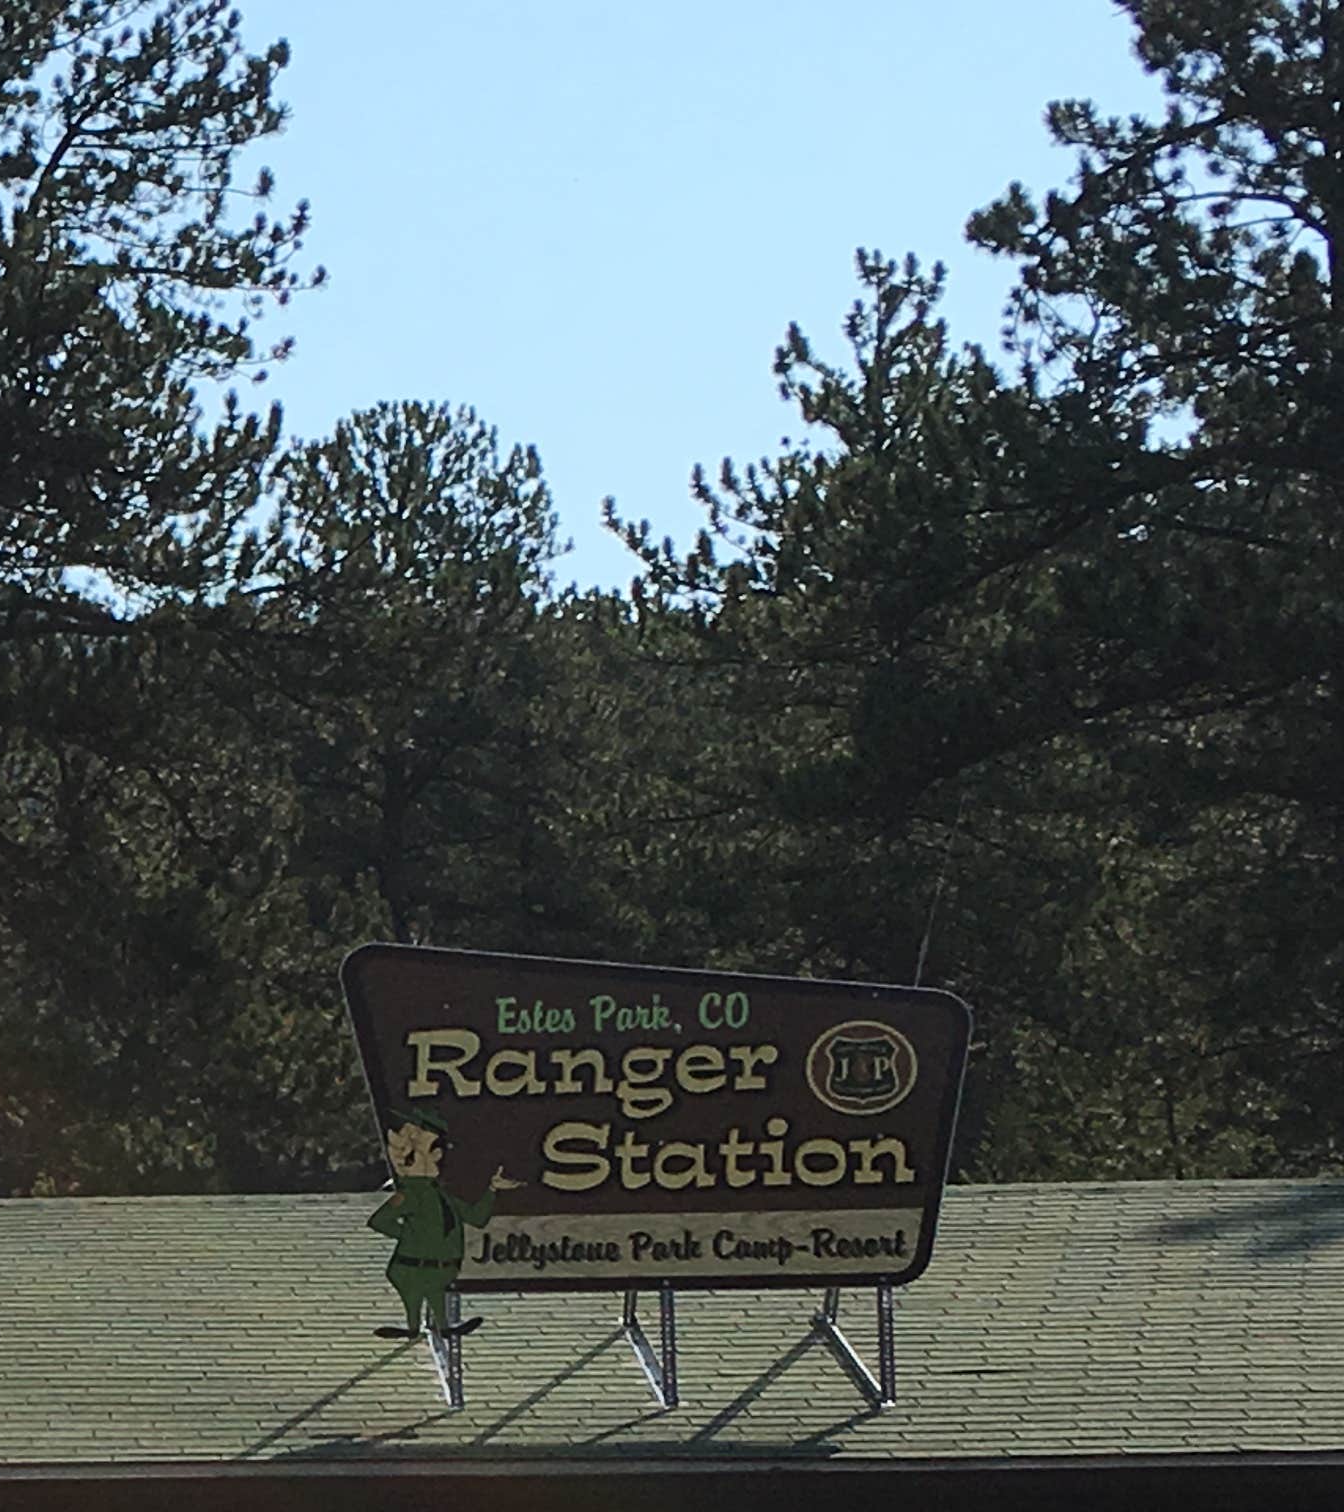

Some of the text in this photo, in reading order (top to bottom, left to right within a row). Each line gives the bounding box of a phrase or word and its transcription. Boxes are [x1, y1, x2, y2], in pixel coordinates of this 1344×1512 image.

[497, 992, 750, 1034] Estes Park, CO
[406, 1028, 779, 1118] Ranger
[835, 1056, 891, 1082] J P
[542, 1118, 916, 1191] Station
[472, 1229, 908, 1270] Jellystone Park Camp-Resort
